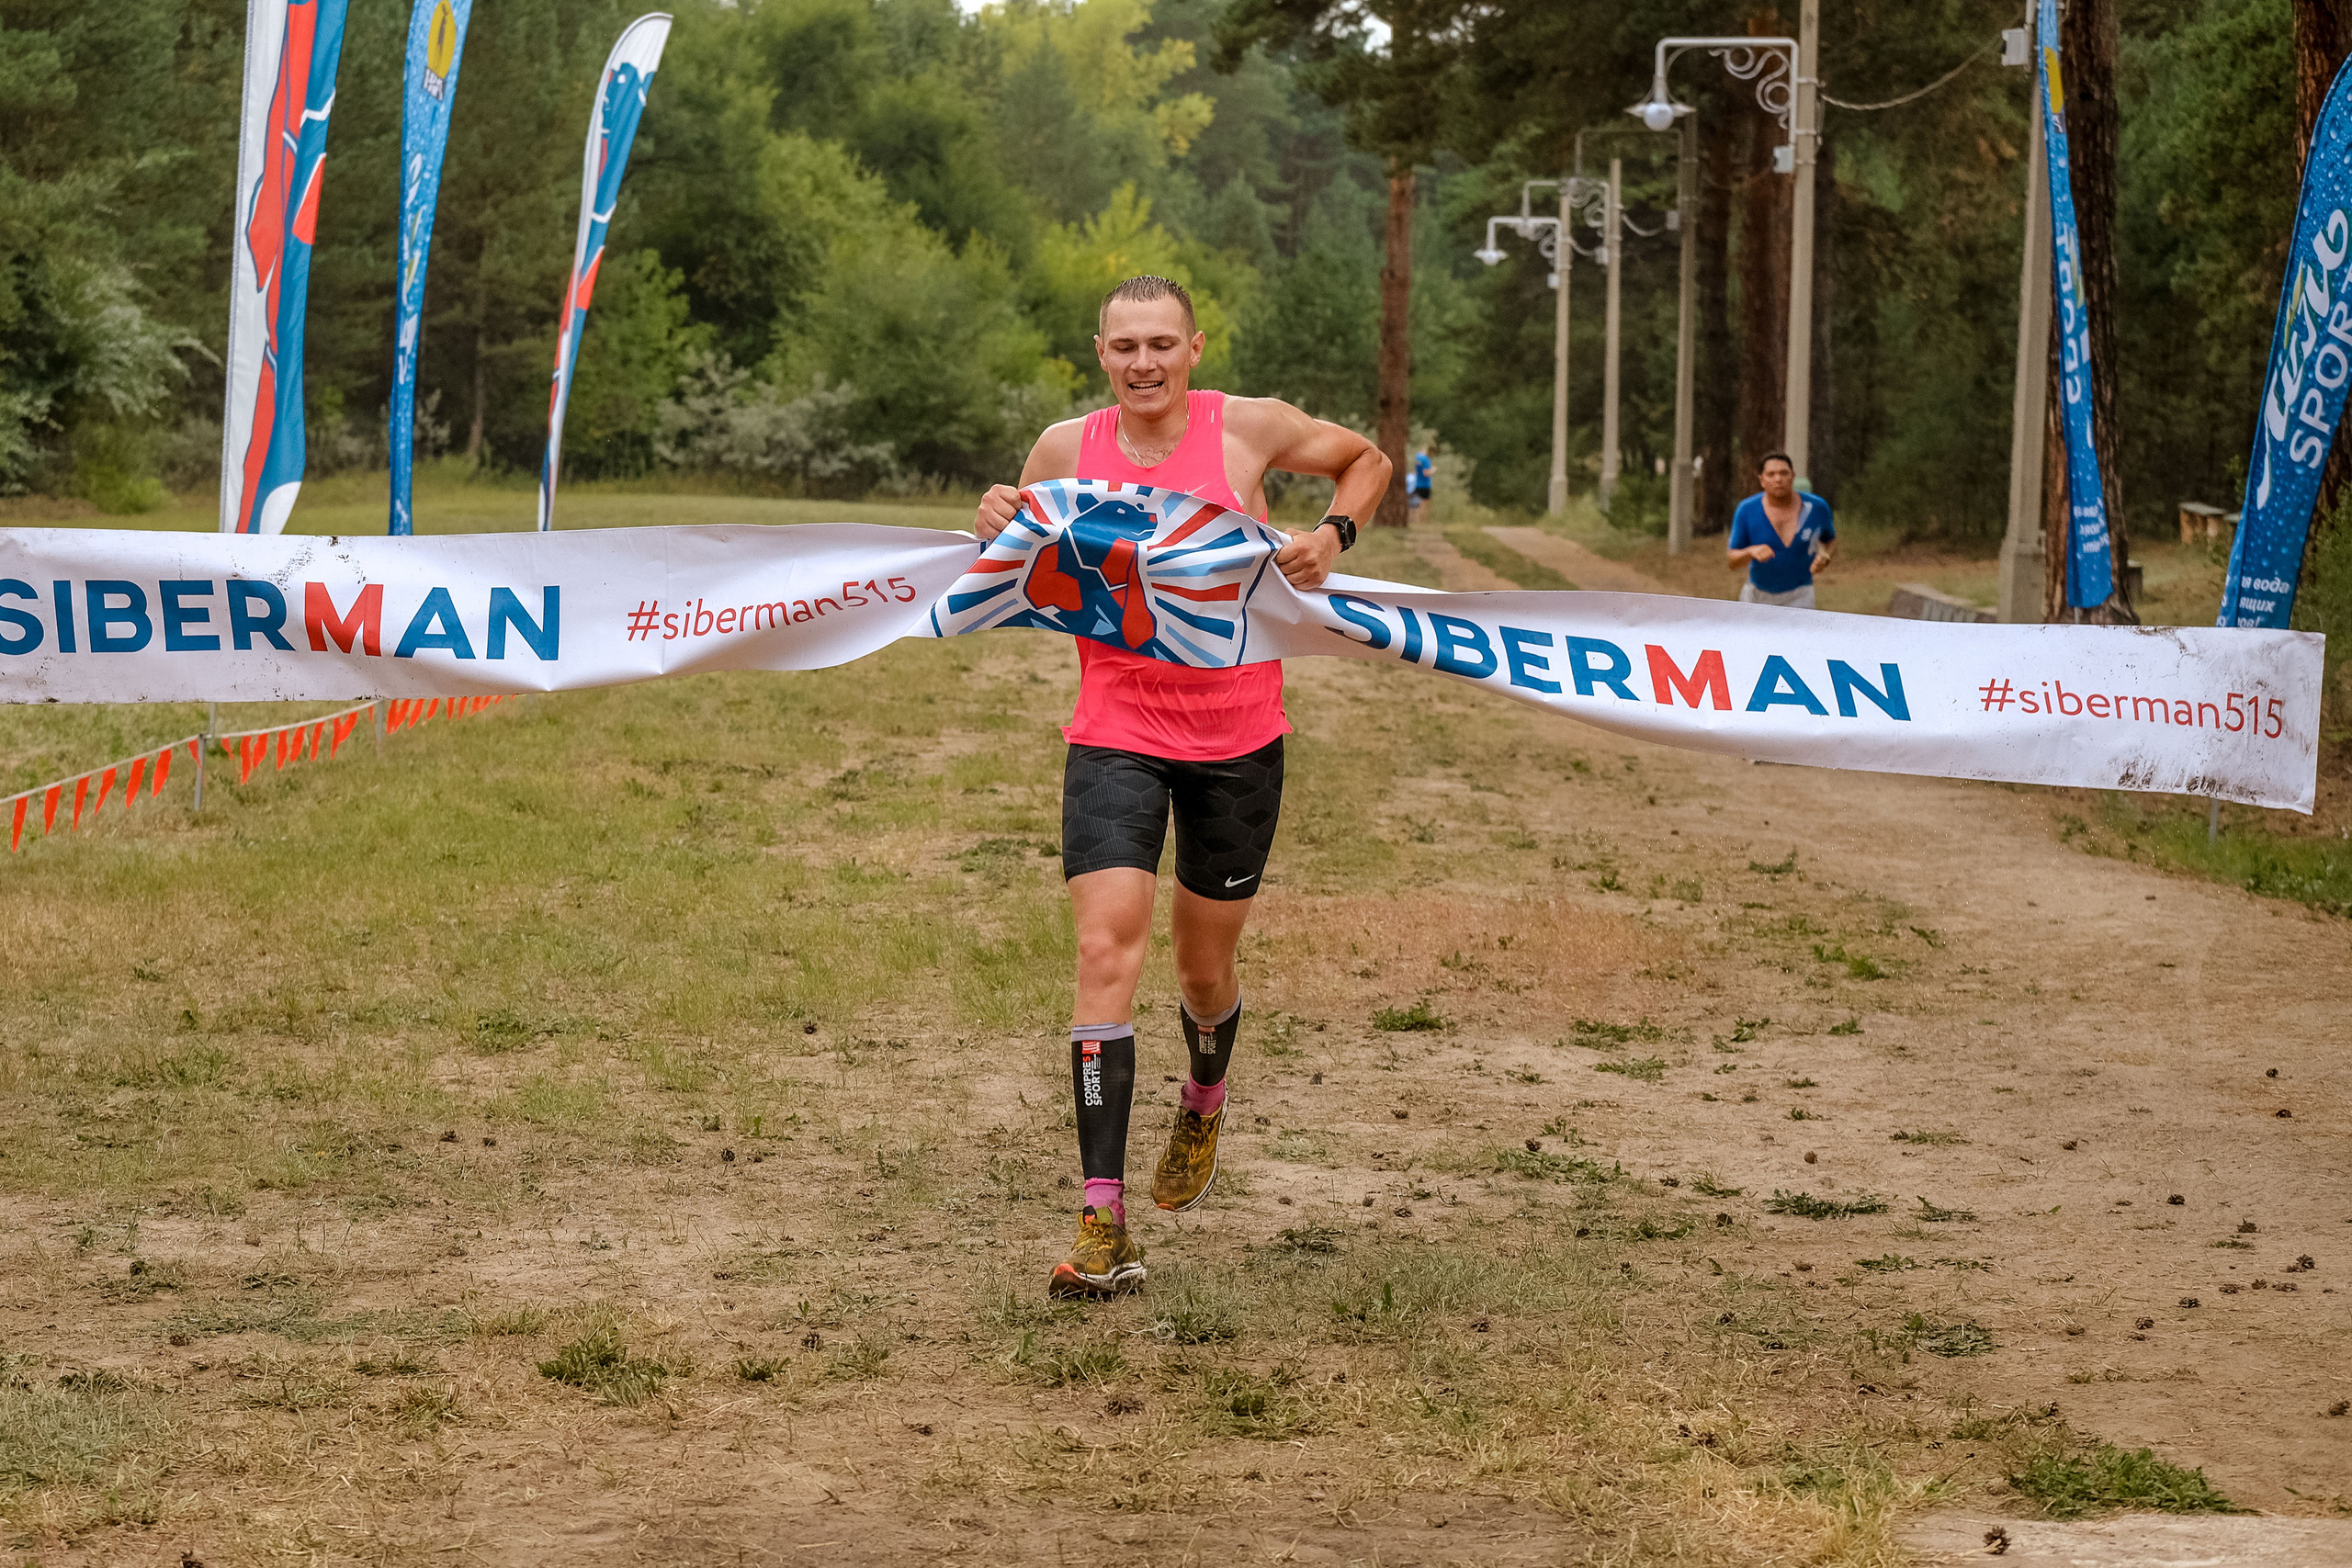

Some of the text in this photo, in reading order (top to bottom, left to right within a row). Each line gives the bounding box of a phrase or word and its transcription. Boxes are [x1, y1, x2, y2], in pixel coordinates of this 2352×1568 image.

[0, 578, 560, 661] SIBERMAN
[628, 576, 916, 642] #siberman515
[1324, 593, 1912, 722] SIBERMAN
[1979, 678, 2284, 739] #siberman515
[1082, 1055, 1093, 1107] COMPRES
[1091, 1069, 1102, 1107] SPORT
